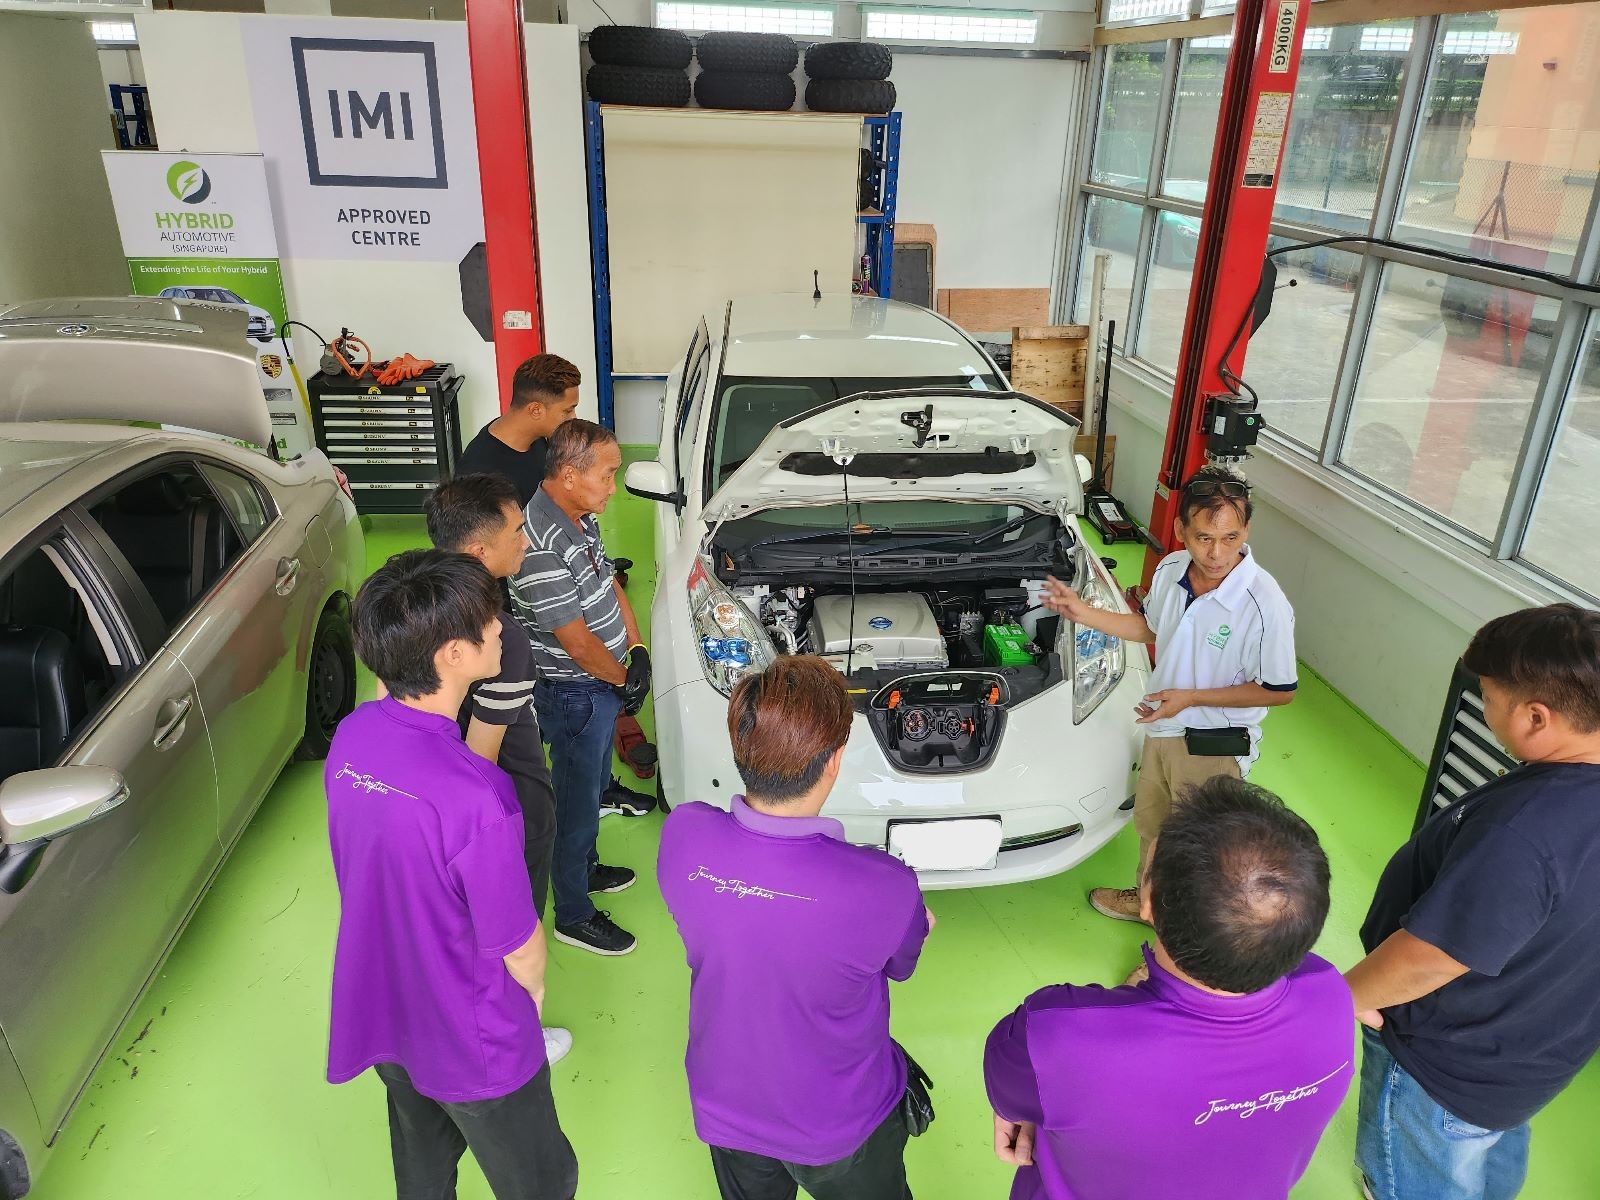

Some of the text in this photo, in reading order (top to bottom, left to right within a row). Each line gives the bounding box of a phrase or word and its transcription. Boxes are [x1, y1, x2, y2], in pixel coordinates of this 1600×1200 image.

[1274, 8, 1293, 66] 4000KG
[328, 90, 414, 140] IMI
[155, 212, 234, 229] HYBRID
[337, 209, 431, 225] APPROVED
[160, 231, 236, 242] AUTOMOTIVE
[352, 231, 421, 246] CENTRE
[172, 244, 228, 254] (SINGAPORE)
[140, 265, 268, 275] Extending the Life of Your Hybrid
[335, 762, 362, 789] Journey
[688, 865, 727, 893] Journey
[1194, 1099, 1257, 1125] Journey
